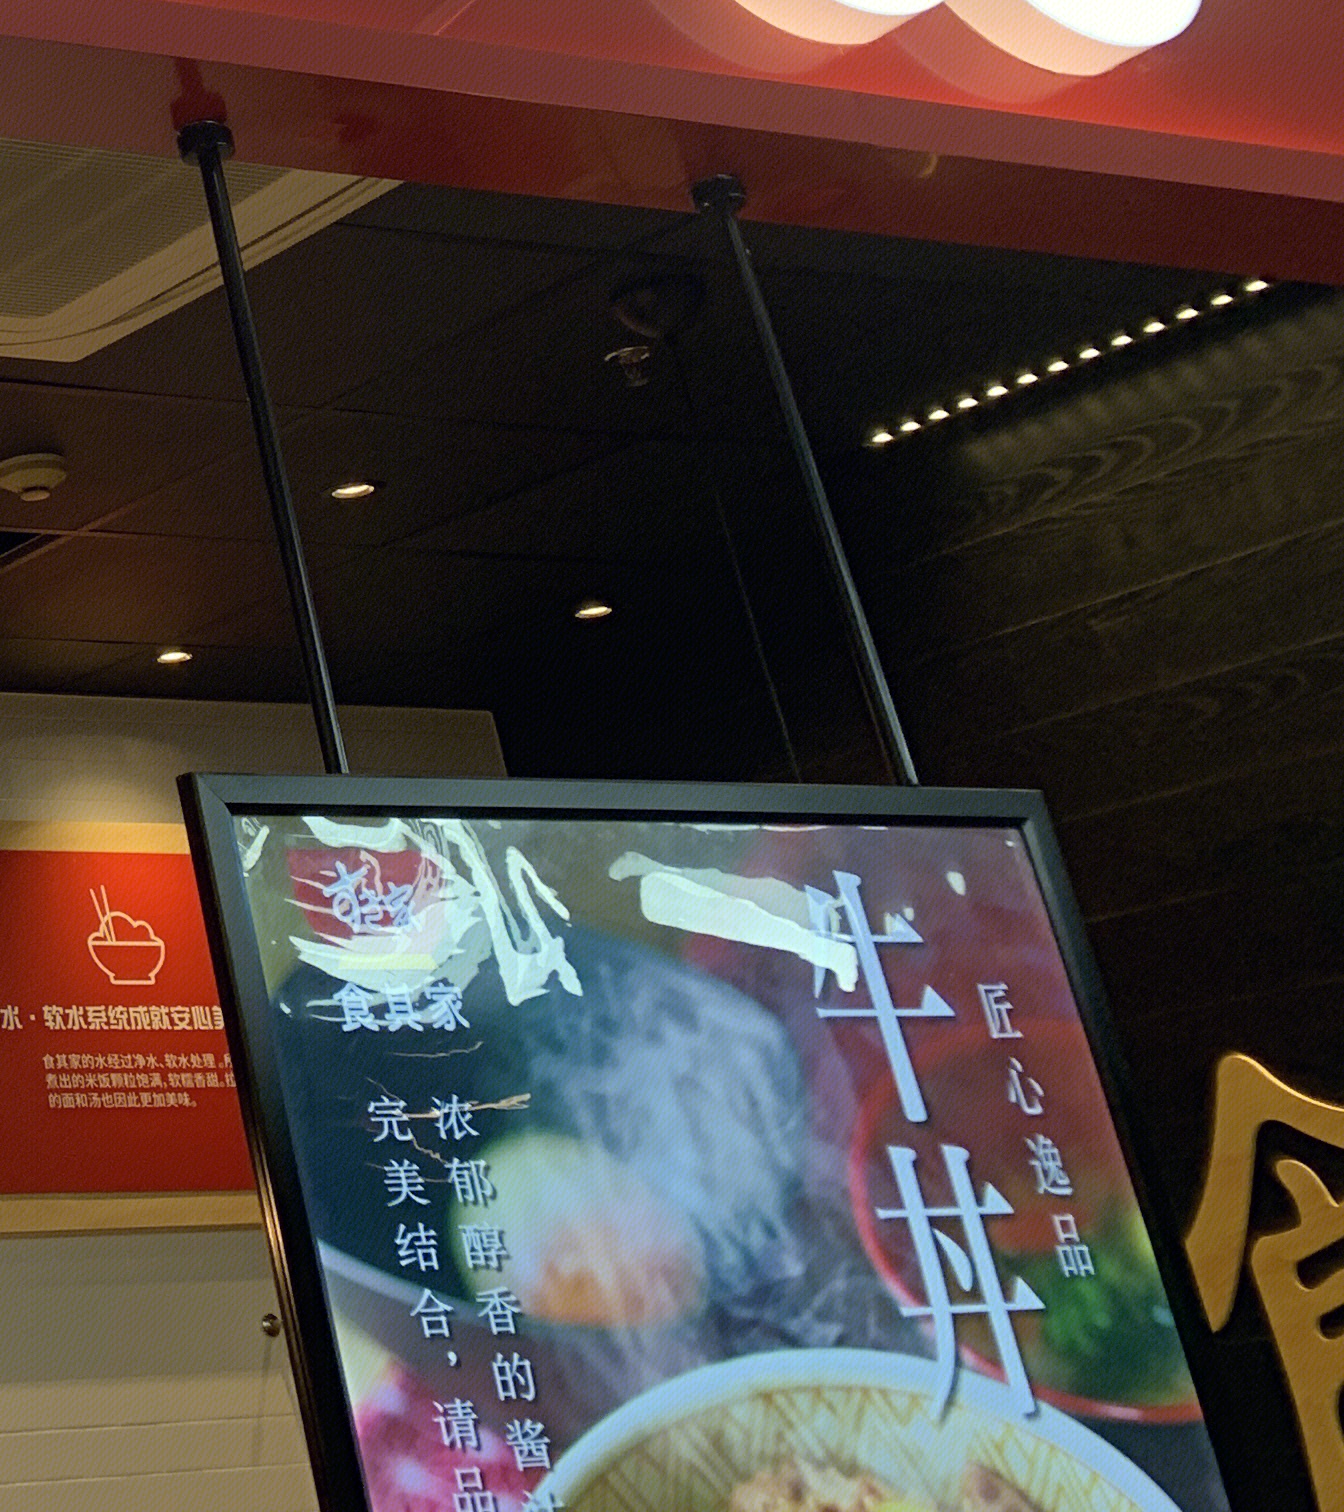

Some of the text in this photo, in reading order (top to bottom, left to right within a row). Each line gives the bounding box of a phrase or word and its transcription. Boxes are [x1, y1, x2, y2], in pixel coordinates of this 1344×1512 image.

[333, 981, 470, 1032] 食其家
[805, 869, 1045, 1424] 牛丼
[977, 983, 1094, 1278] 匠心逸品
